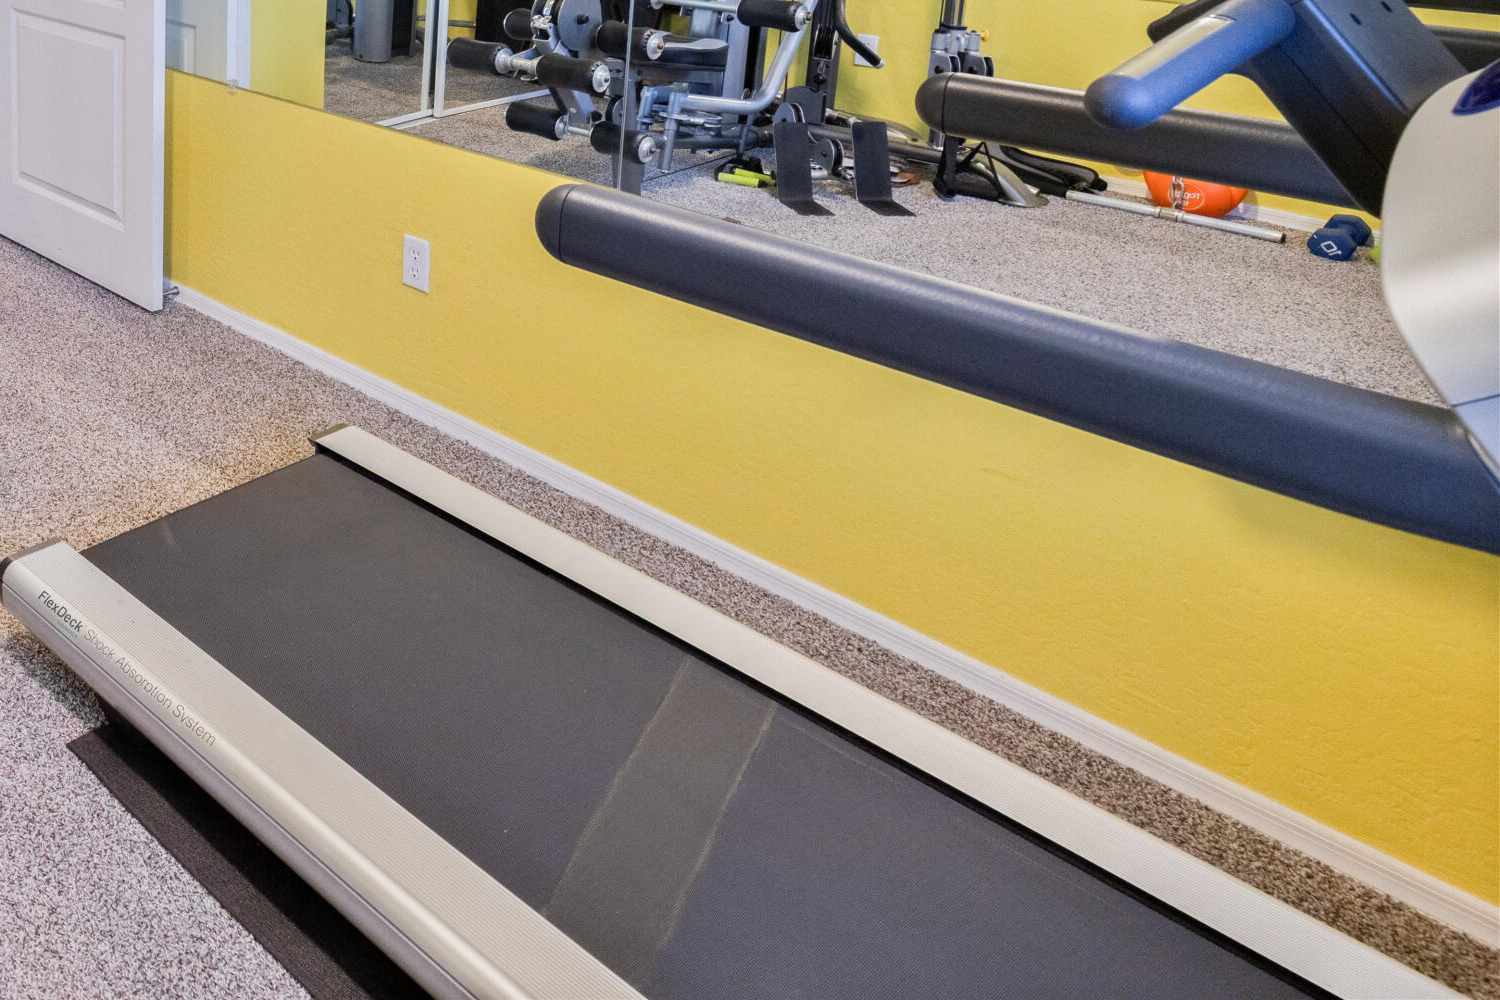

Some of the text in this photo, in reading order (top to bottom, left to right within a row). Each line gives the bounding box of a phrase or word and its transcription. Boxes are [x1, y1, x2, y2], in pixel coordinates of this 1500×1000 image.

[37, 590, 83, 633] FlexDeck
[84, 629, 116, 659] Shock
[115, 657, 173, 710] Absorption
[172, 704, 216, 746] System
